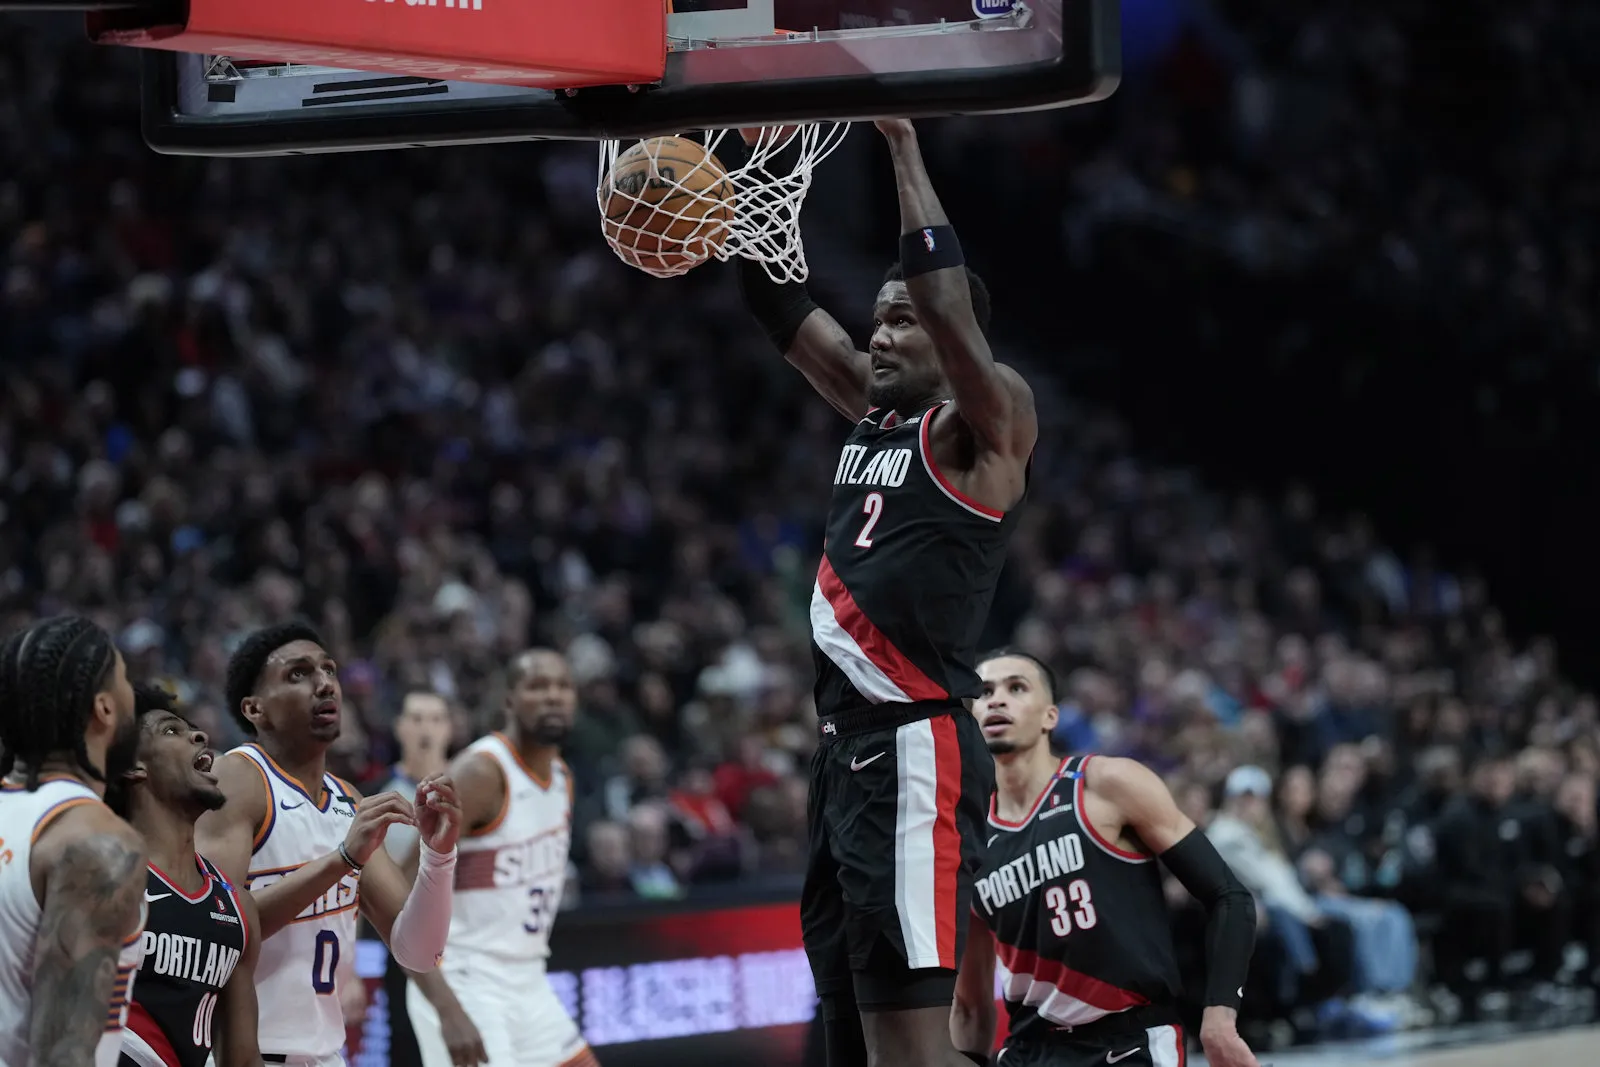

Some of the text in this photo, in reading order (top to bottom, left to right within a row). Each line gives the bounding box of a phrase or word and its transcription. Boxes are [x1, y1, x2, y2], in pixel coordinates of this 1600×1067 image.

[834, 444, 913, 488] RTLAND
[854, 491, 885, 549] 2
[974, 833, 1085, 917] PORTLAND
[1044, 878, 1098, 938] 33
[137, 930, 241, 988] PORTLAND
[312, 929, 340, 996] 0
[192, 991, 219, 1048] 00
